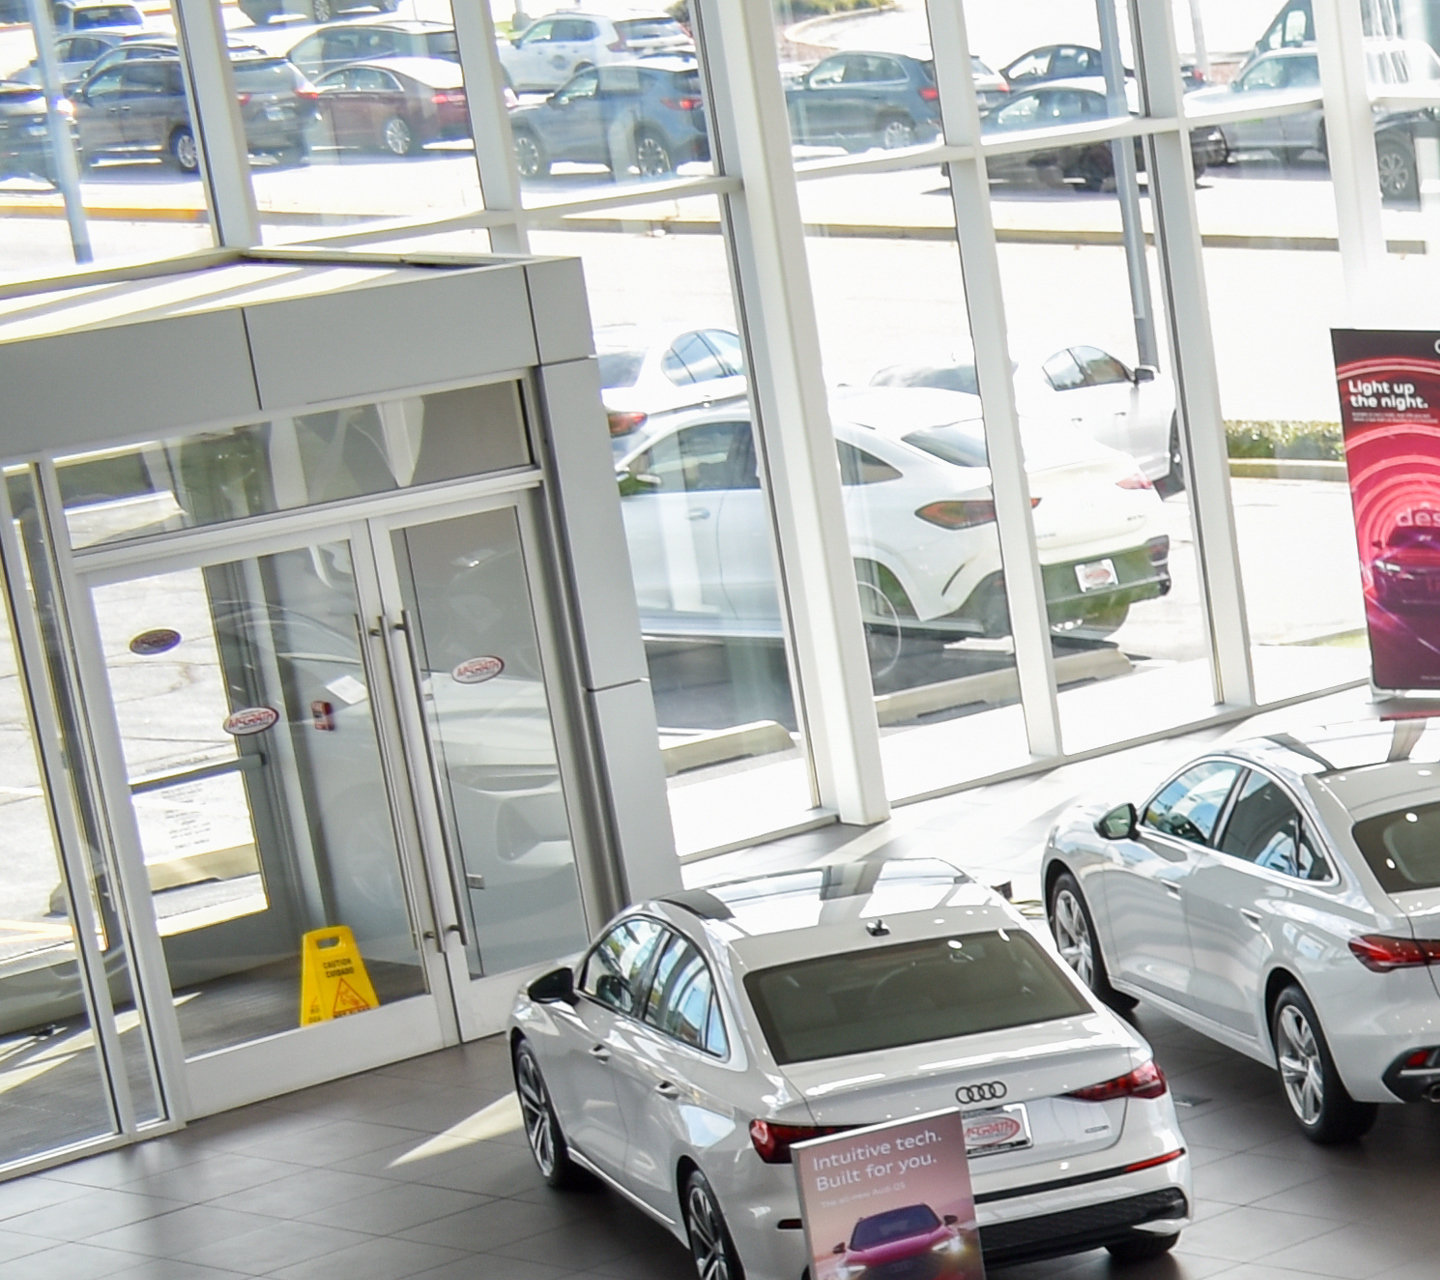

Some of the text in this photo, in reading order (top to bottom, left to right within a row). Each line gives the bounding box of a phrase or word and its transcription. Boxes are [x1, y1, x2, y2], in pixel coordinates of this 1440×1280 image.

[1348, 380, 1414, 398] Light up
[1350, 394, 1429, 411] the night.
[813, 1130, 942, 1172] Intuitive tech.
[816, 1153, 937, 1192] Built for you.
